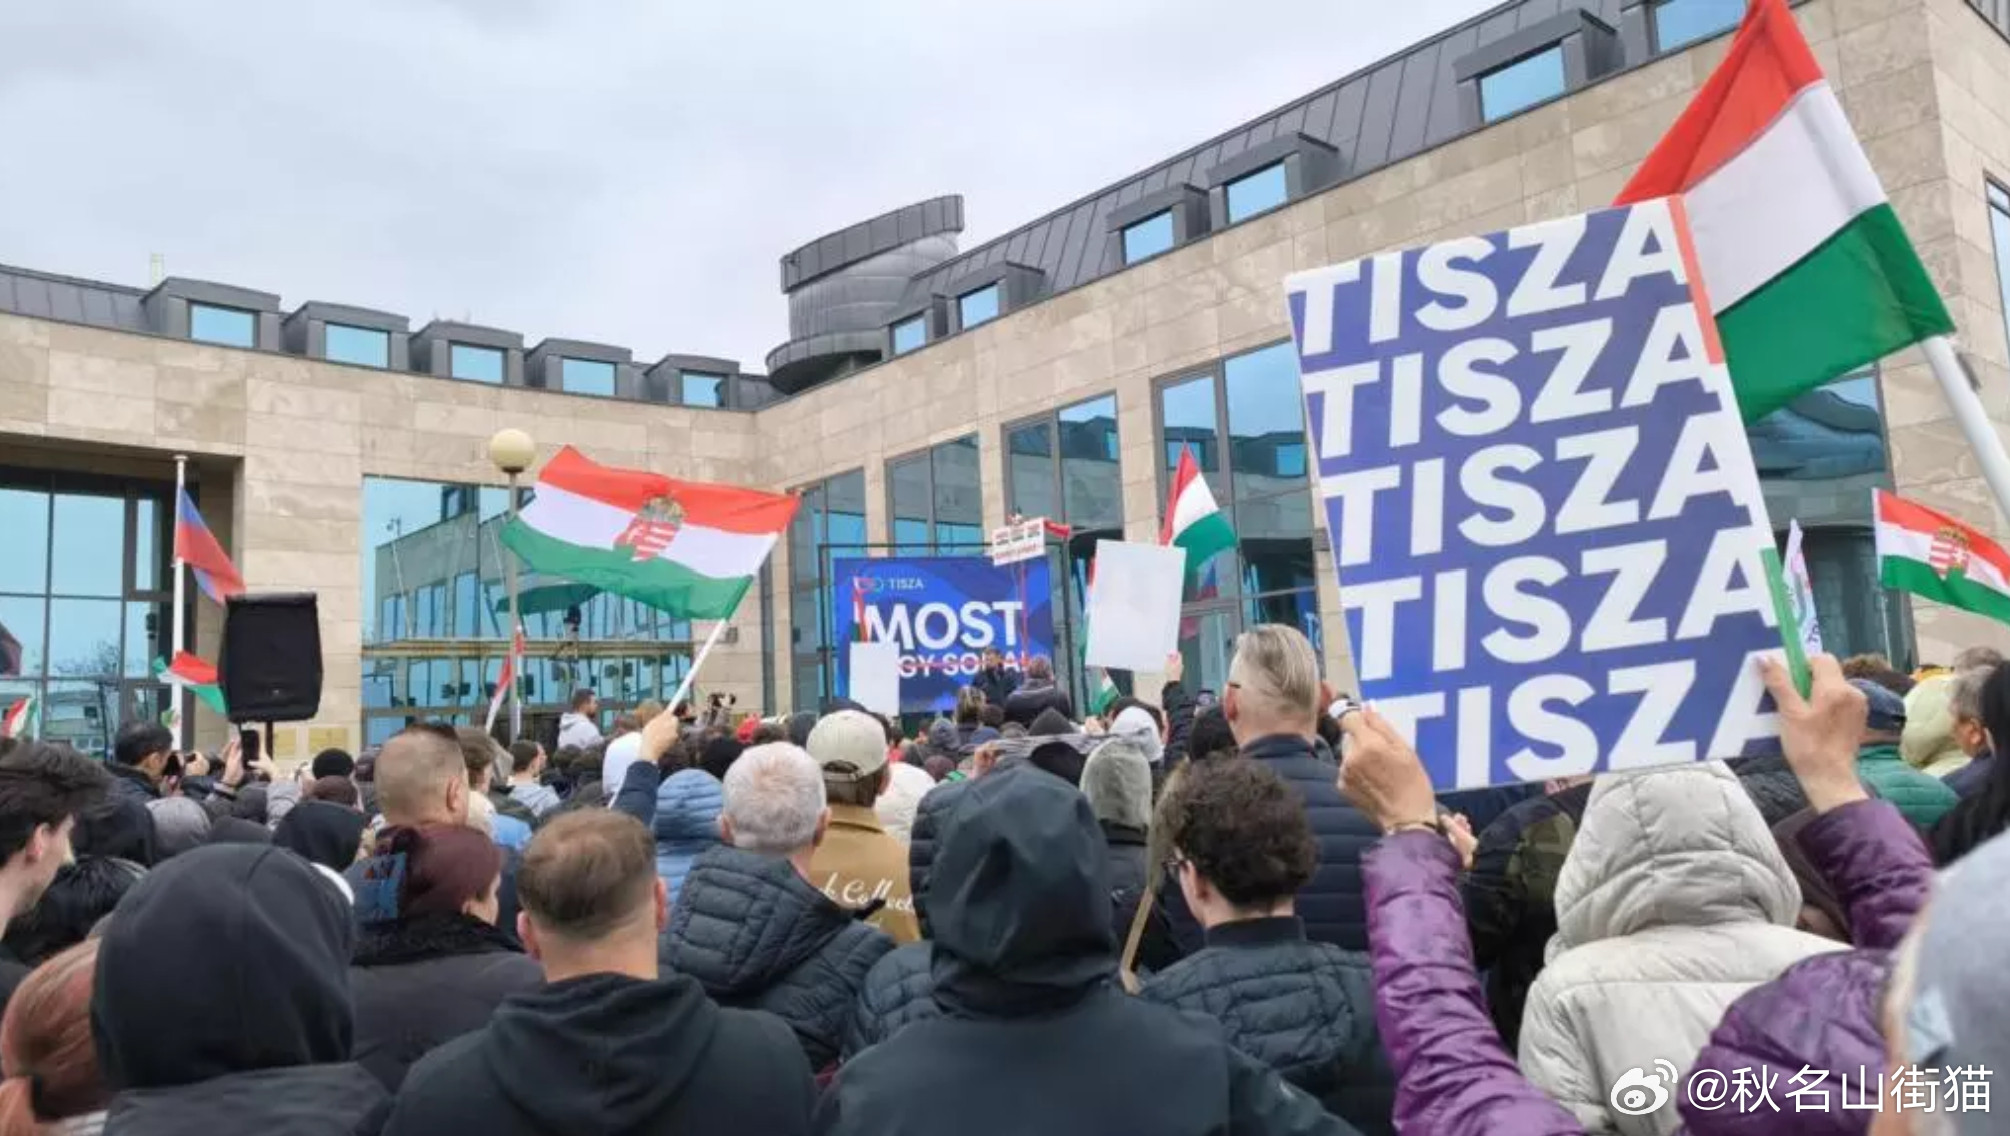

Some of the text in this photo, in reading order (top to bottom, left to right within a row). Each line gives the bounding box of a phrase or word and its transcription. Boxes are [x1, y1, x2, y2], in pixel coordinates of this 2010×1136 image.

[1287, 200, 1691, 356] TISZA
[1301, 302, 1723, 459] TISZA
[1319, 411, 1755, 567] TISZA
[863, 600, 1024, 650] MOST
[888, 577, 924, 590] TISZA
[1340, 525, 1782, 682] TISZA
[898, 654, 935, 678] GY
